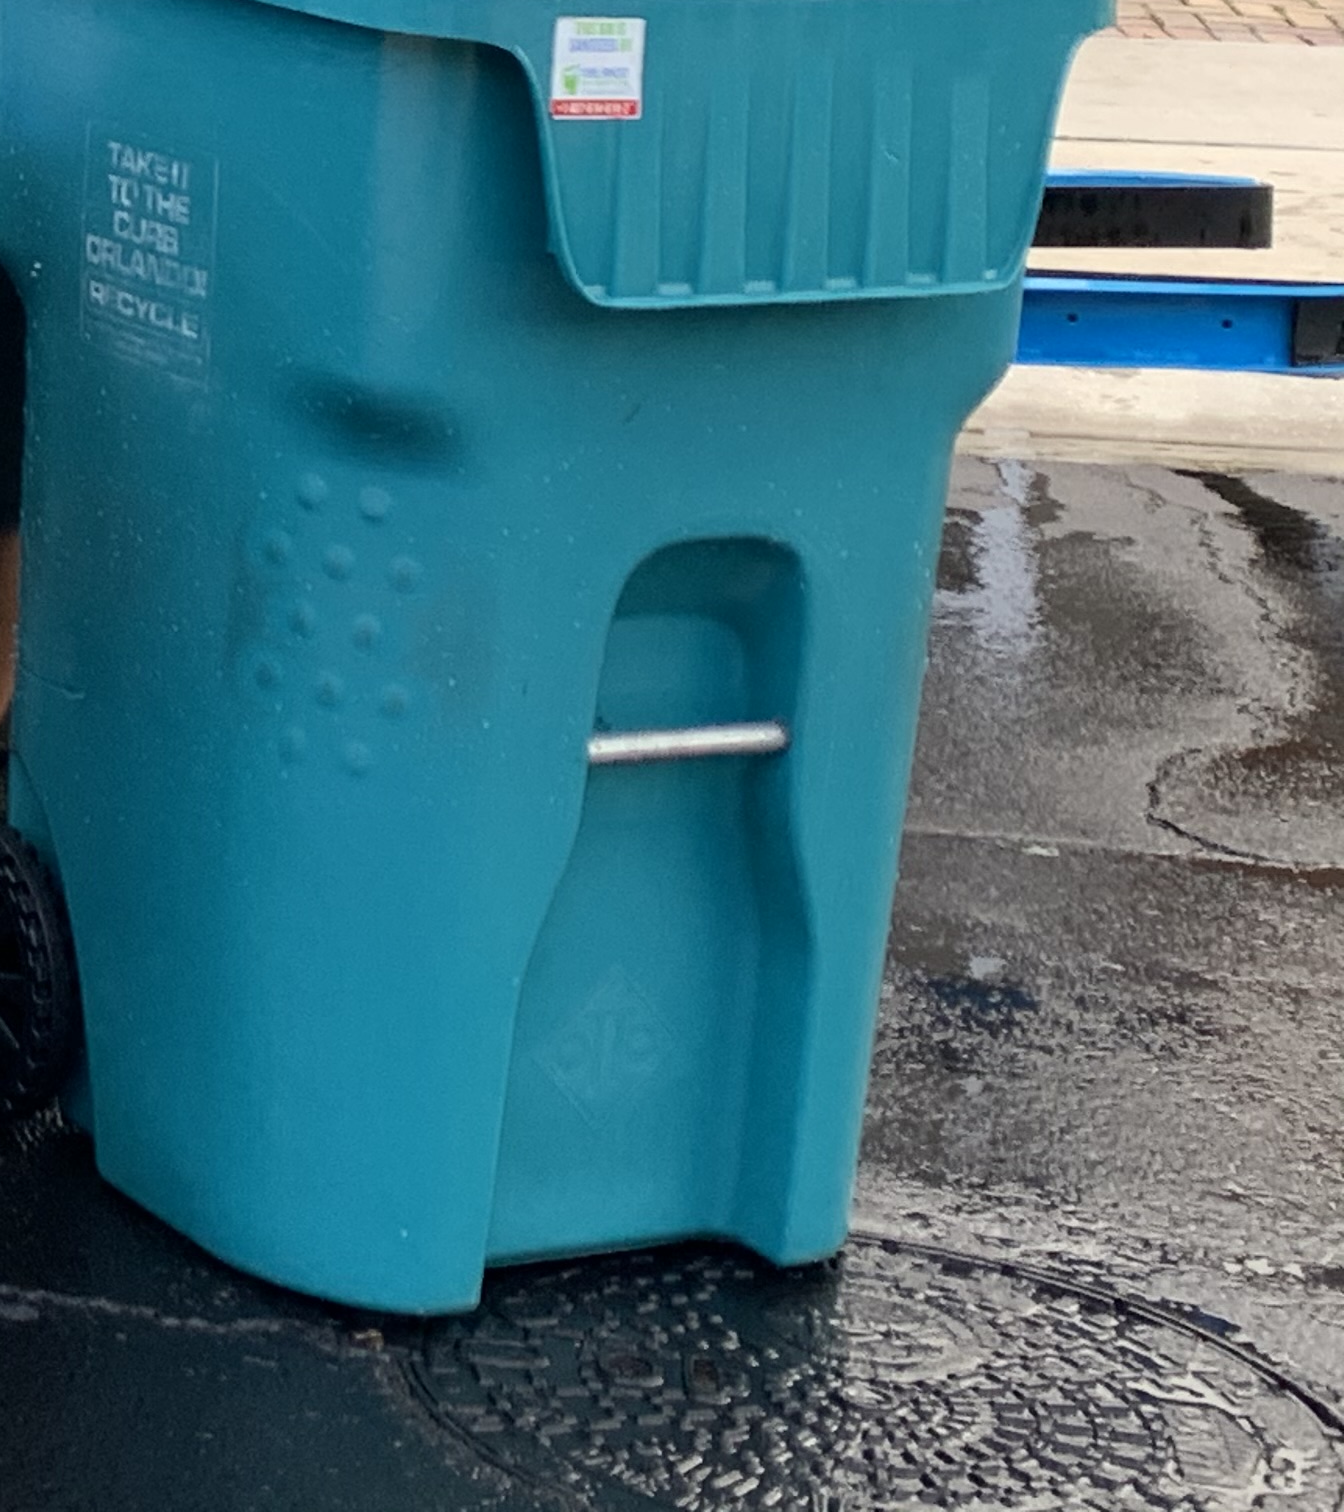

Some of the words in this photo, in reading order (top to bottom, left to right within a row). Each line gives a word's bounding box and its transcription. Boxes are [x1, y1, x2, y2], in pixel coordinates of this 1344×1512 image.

[108, 141, 168, 183] TAKE
[142, 185, 190, 225] THE
[89, 279, 199, 339] RCYCLE
